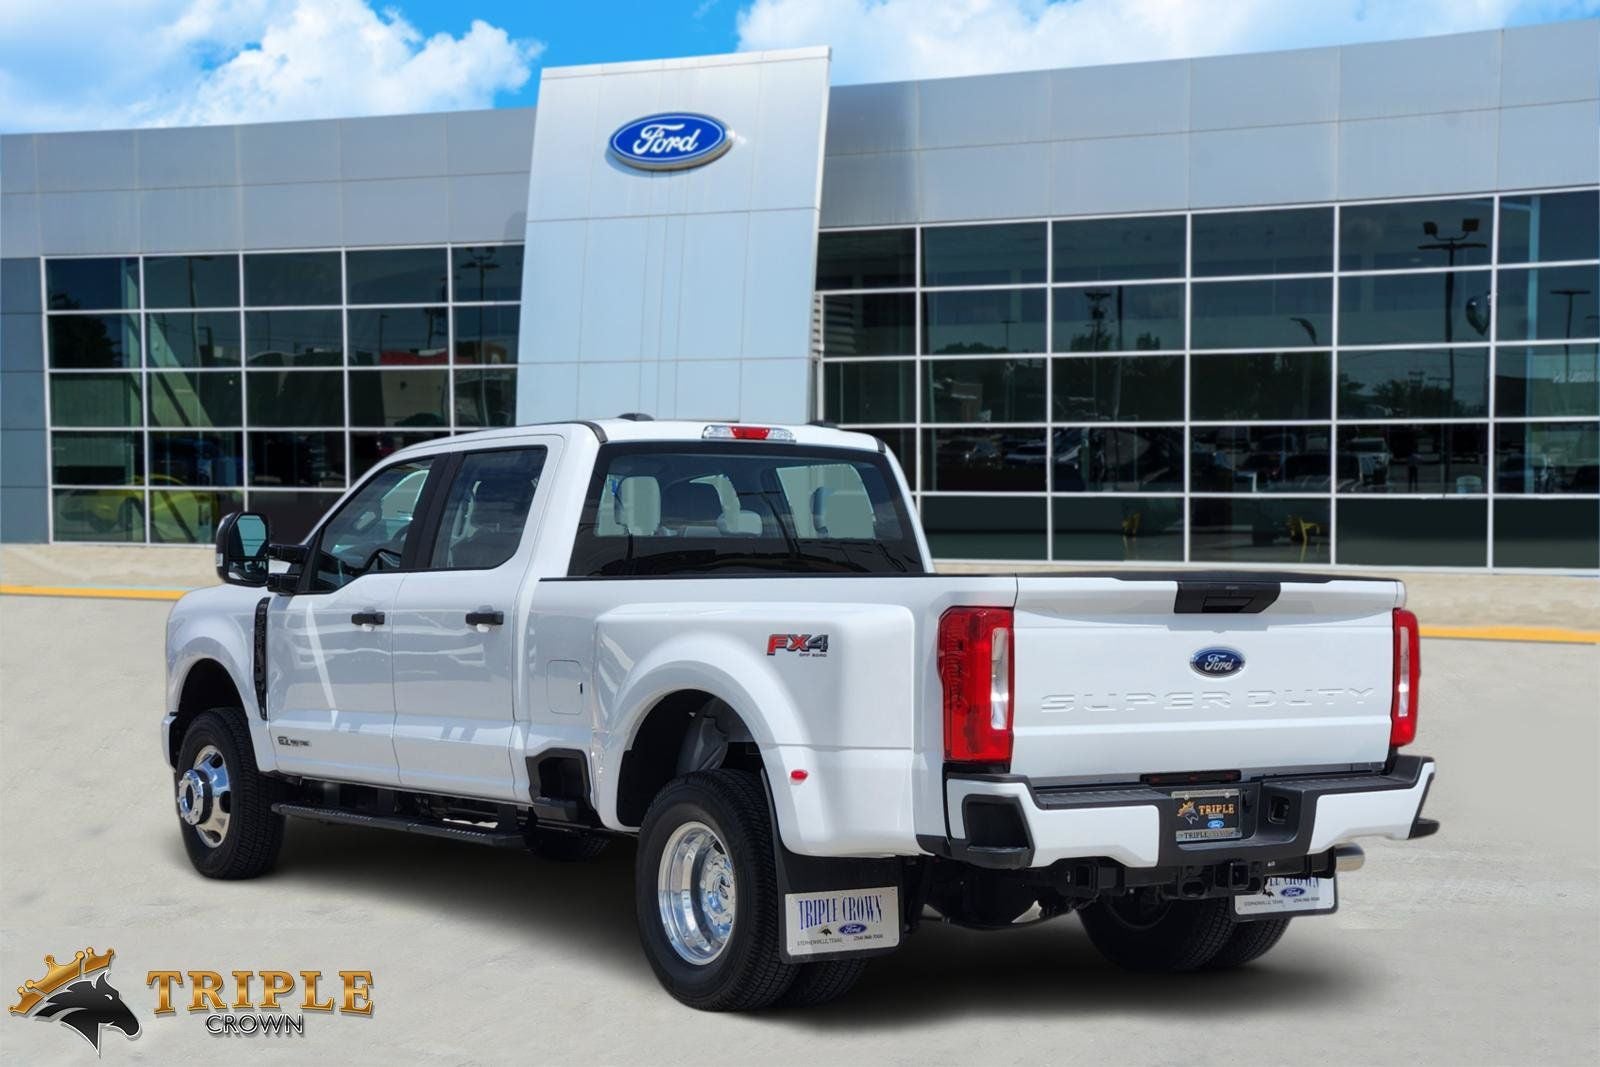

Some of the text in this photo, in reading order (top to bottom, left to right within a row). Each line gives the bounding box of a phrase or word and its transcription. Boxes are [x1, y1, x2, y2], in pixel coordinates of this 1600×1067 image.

[633, 123, 702, 155] Ford
[767, 633, 829, 656] FX4
[1204, 653, 1234, 672] Ford
[1040, 686, 1375, 712] SUPER DUTY
[1199, 803, 1235, 816] TRIPLE
[798, 894, 883, 930] TRIPLE CROWN
